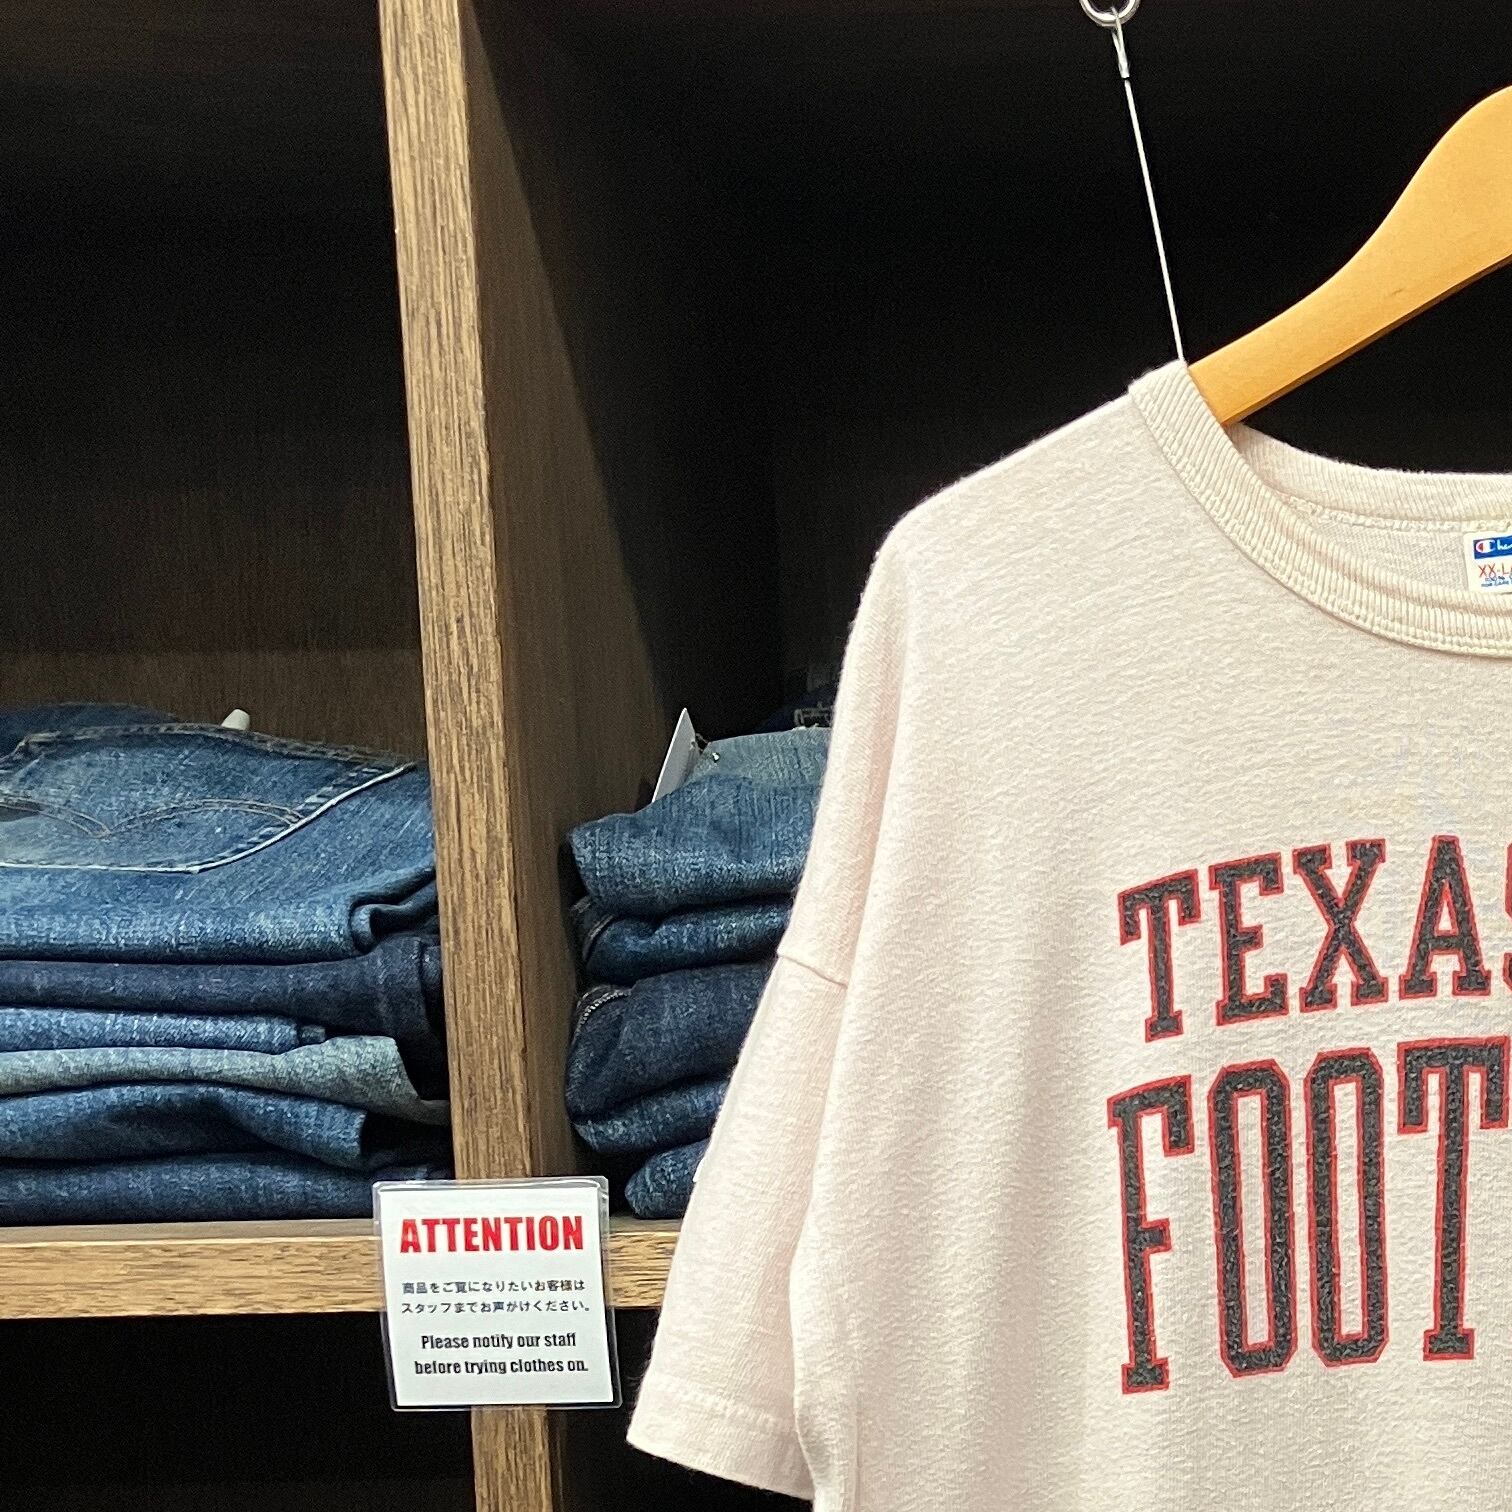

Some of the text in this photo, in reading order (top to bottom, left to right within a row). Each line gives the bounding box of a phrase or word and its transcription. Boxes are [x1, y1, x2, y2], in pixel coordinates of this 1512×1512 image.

[400, 1215, 584, 1254] ATTENTION
[402, 1279, 585, 1295] 商品をご覧になりたいお客様は
[401, 1300, 590, 1314] スタッフまでお声がけください。
[420, 1332, 577, 1349] Please notify our staff
[414, 1358, 589, 1375] before trying clothes on.
